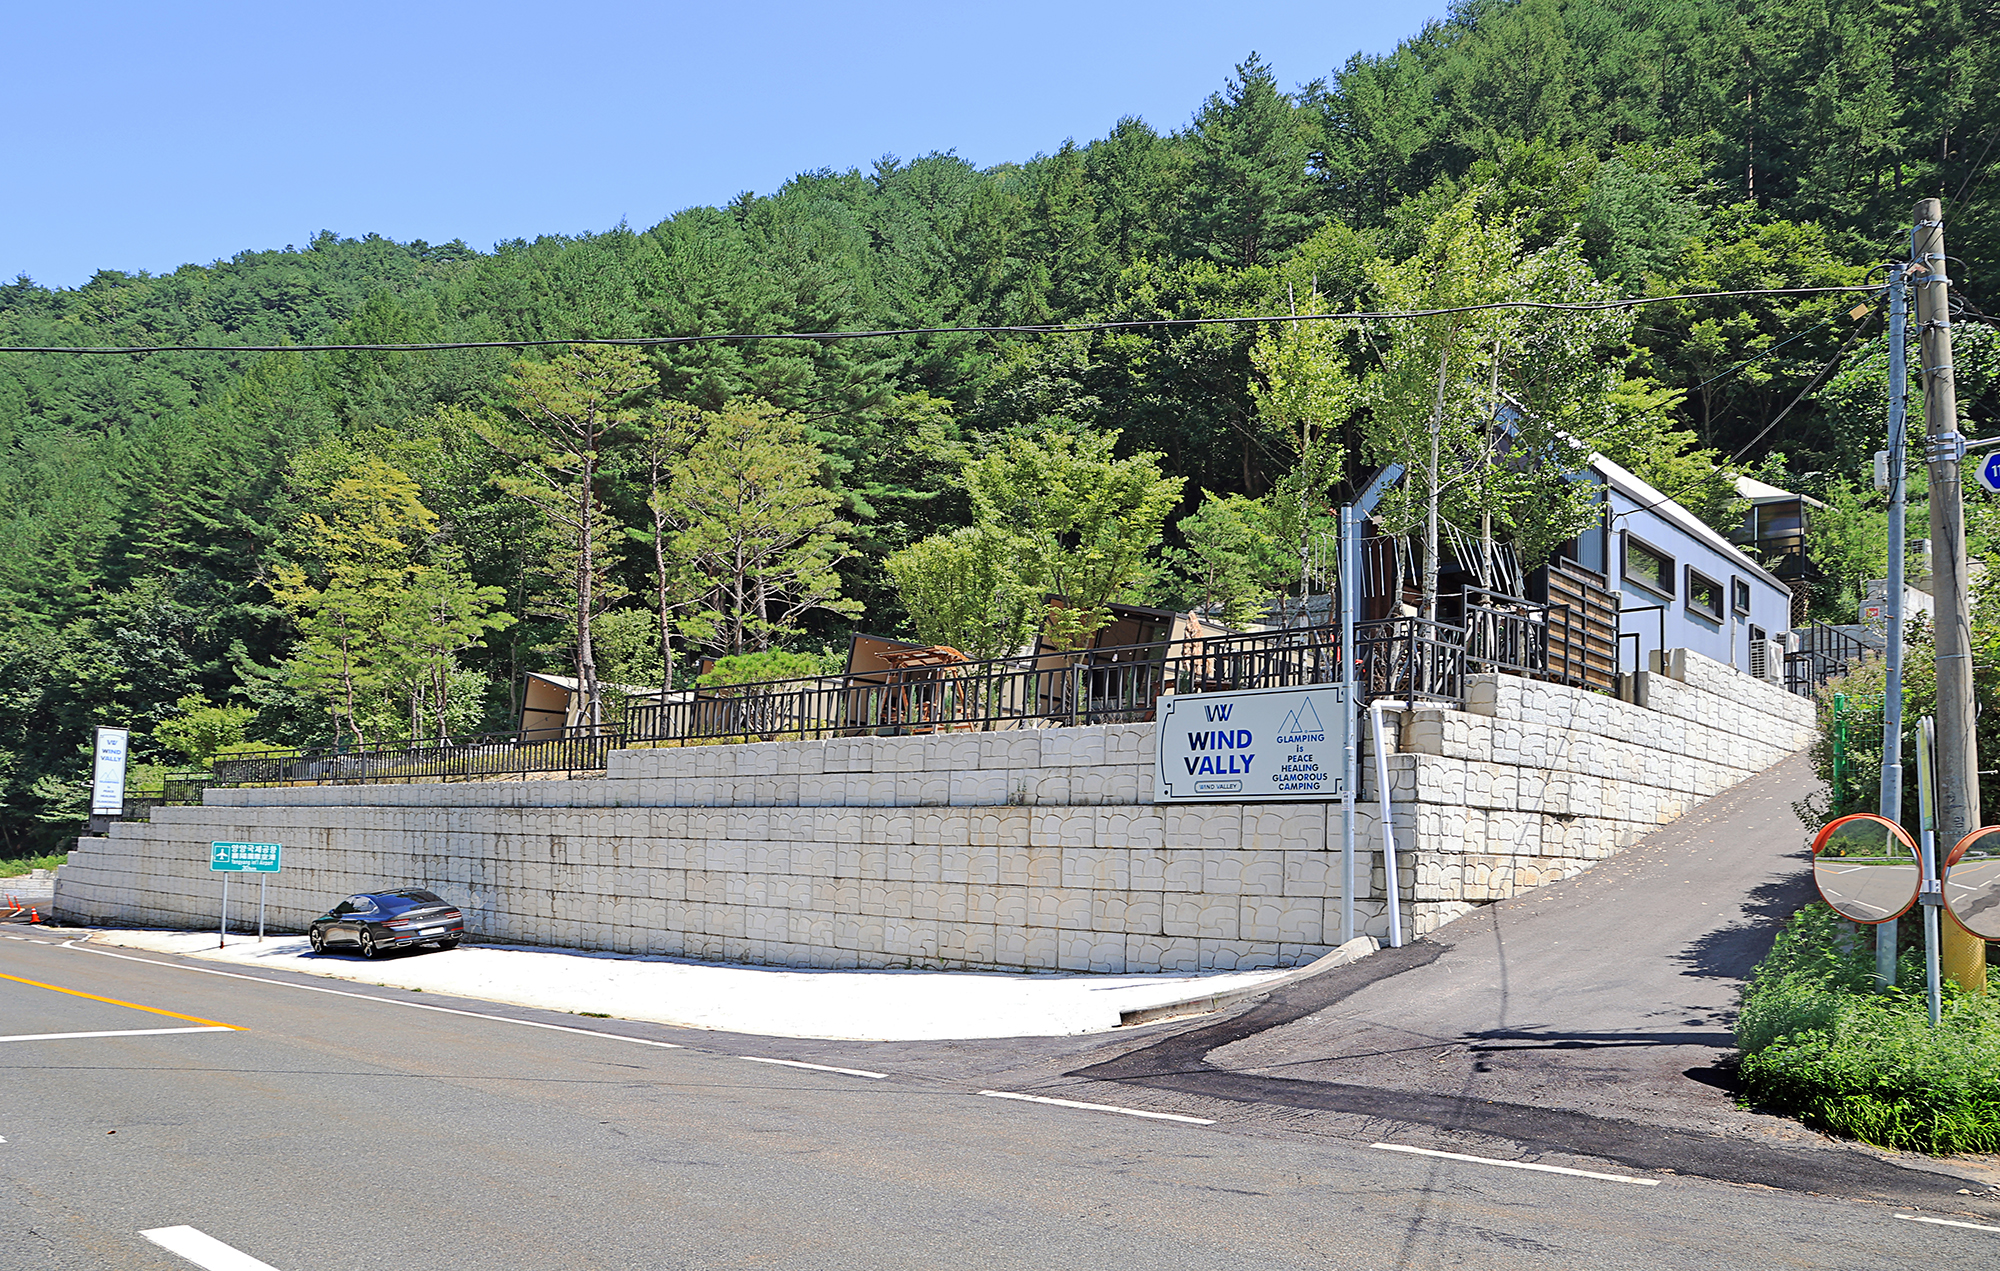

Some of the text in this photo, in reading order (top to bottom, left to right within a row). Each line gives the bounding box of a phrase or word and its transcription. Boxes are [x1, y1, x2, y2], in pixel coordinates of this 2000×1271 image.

[1187, 729, 1253, 751] WIND
[1276, 733, 1325, 744] GLAMPING
[1296, 744, 1304, 753] is
[1287, 754, 1313, 763] PEACE
[1184, 754, 1255, 775] VALLY
[1281, 763, 1319, 772] HEALING
[1272, 772, 1328, 782] GLAMOROUS
[1278, 782, 1320, 791] CAMPING
